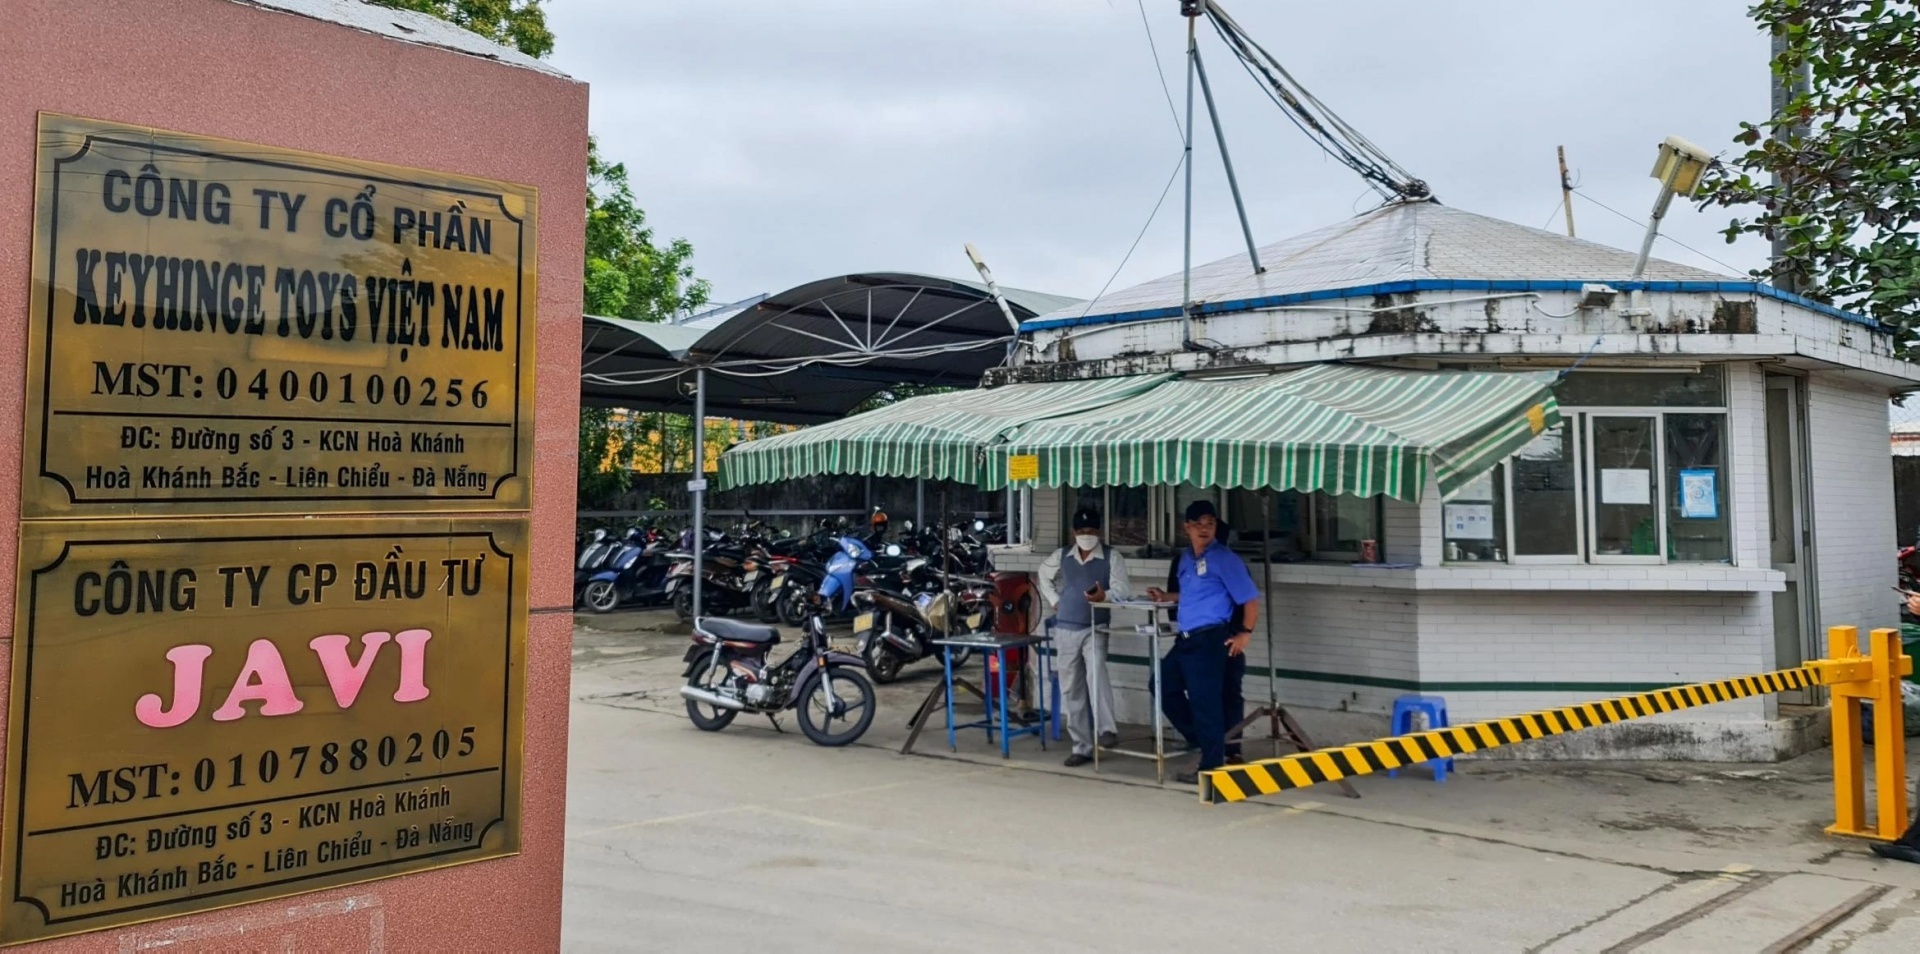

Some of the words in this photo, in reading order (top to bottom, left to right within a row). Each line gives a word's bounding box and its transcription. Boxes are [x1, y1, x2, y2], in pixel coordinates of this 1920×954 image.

[101, 163, 232, 226] CÔNG
[252, 187, 306, 233] TY
[324, 183, 376, 241] CỔ
[393, 199, 492, 255] PHẦN
[73, 247, 266, 336] KEYHINGE
[275, 267, 358, 343] TOYS
[365, 257, 435, 363] VIỆT
[440, 284, 505, 352] NAM
[91, 361, 205, 399] MST:
[120, 425, 161, 451] ĐC:
[171, 427, 241, 455] Đường
[249, 425, 278, 450] số
[281, 429, 294, 450] 3
[318, 431, 360, 452] KCN
[367, 431, 402, 452] Hoà
[410, 432, 465, 454] Khánh
[86, 465, 131, 489] Hoà
[143, 466, 213, 489] Khánh
[221, 465, 260, 488] Bắc
[286, 466, 328, 488] Liên
[337, 463, 389, 487] Chiểu
[412, 466, 437, 487] Đà
[444, 464, 487, 492] Nẵng
[73, 559, 197, 617] CÔNG
[218, 565, 269, 608] TY
[287, 562, 337, 605] CP
[353, 546, 426, 601] ĐẦU
[442, 553, 486, 597] TƯ
[135, 628, 432, 728] JAVI
[66, 763, 180, 809] MST:
[95, 835, 136, 860] ĐC:
[146, 826, 217, 853] Đường
[226, 810, 255, 841] số
[260, 813, 273, 835] 3
[298, 802, 340, 828] KCN
[349, 796, 385, 821] Hoà
[395, 786, 451, 814] Khánh
[60, 882, 107, 908] Hoà
[117, 863, 188, 899] Khánh
[198, 857, 237, 884] Bắc
[263, 849, 307, 873] Liên
[316, 830, 372, 863] Chiểu
[395, 824, 420, 849] Đà
[429, 817, 473, 844] Nẵng
